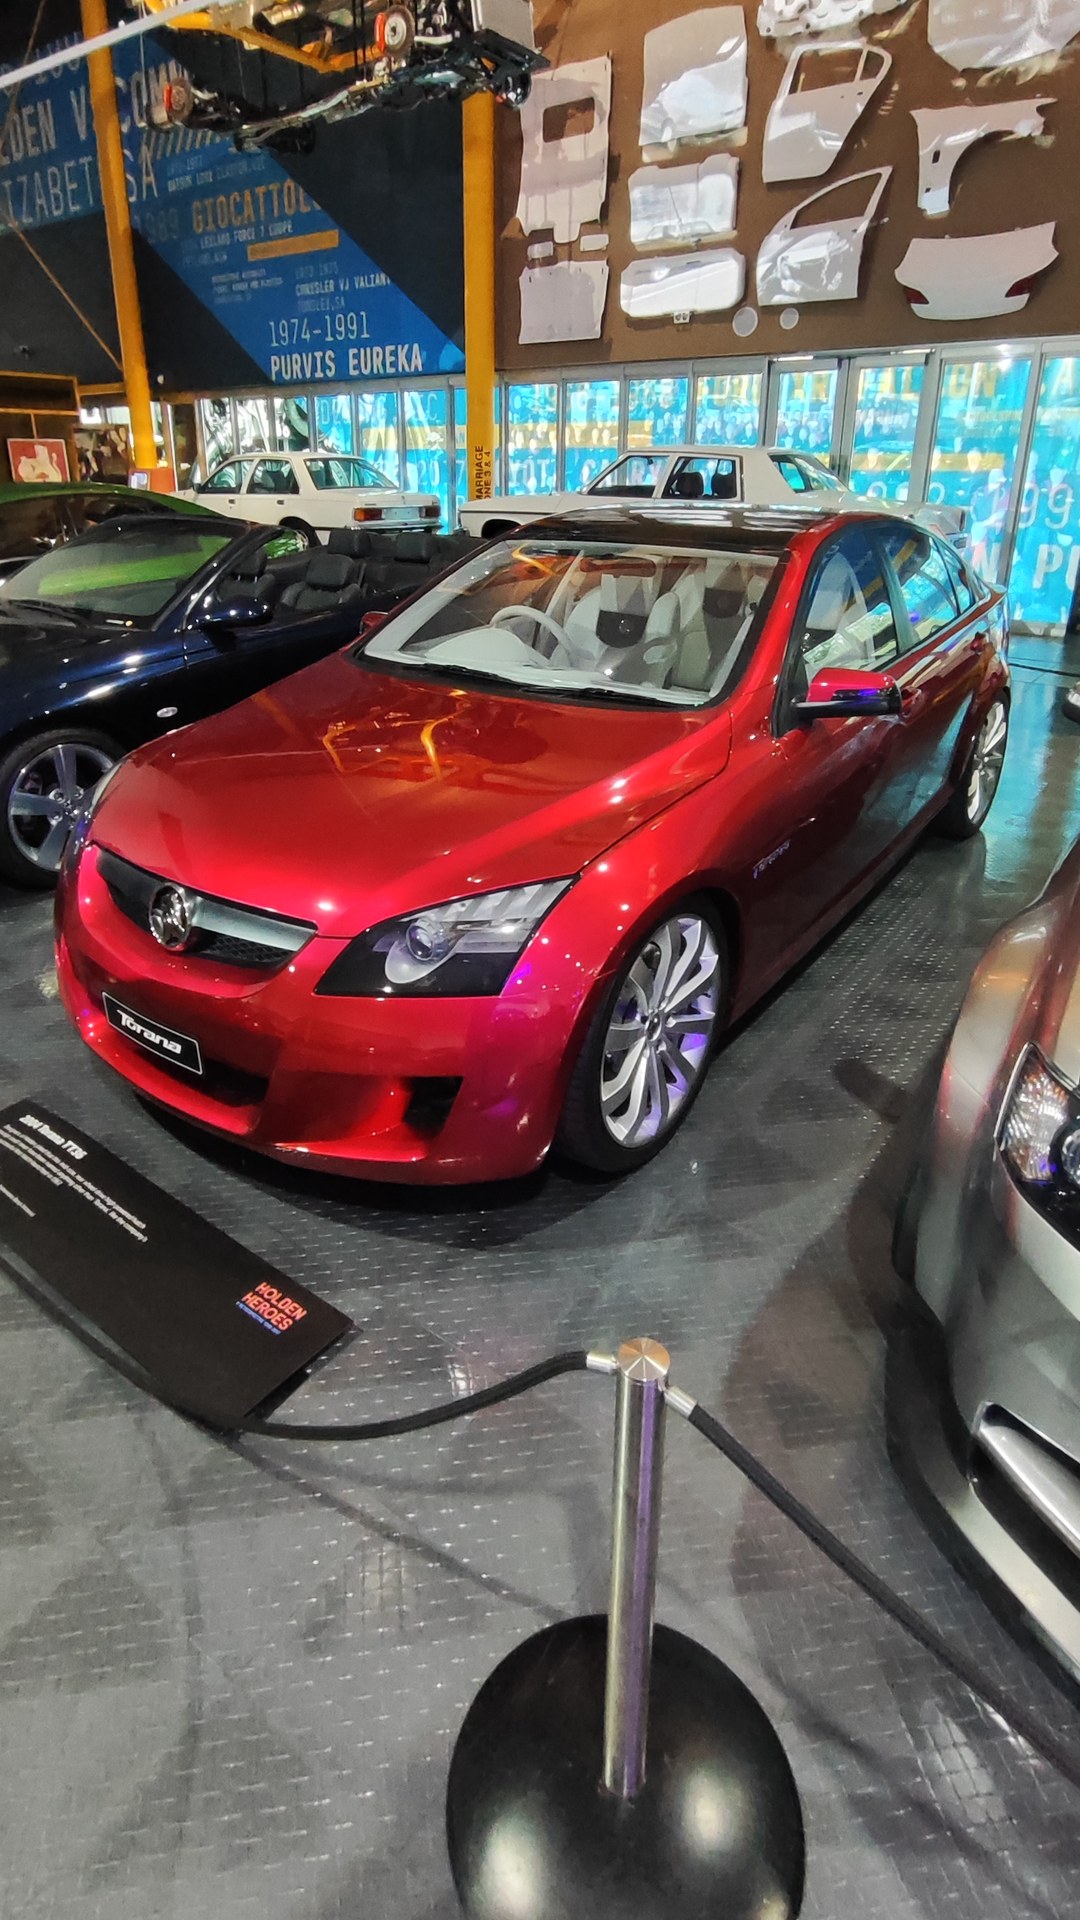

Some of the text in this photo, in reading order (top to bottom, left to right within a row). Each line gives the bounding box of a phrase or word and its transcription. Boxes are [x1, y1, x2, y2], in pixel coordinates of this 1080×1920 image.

[295, 281, 335, 297] CHRYSLER
[268, 311, 371, 348] 1974-1991
[270, 342, 424, 382] PURVIS EUREKA
[116, 1009, 182, 1055] Torana
[241, 1291, 294, 1331] HEROES
[255, 1281, 308, 1321] HOLDEN
